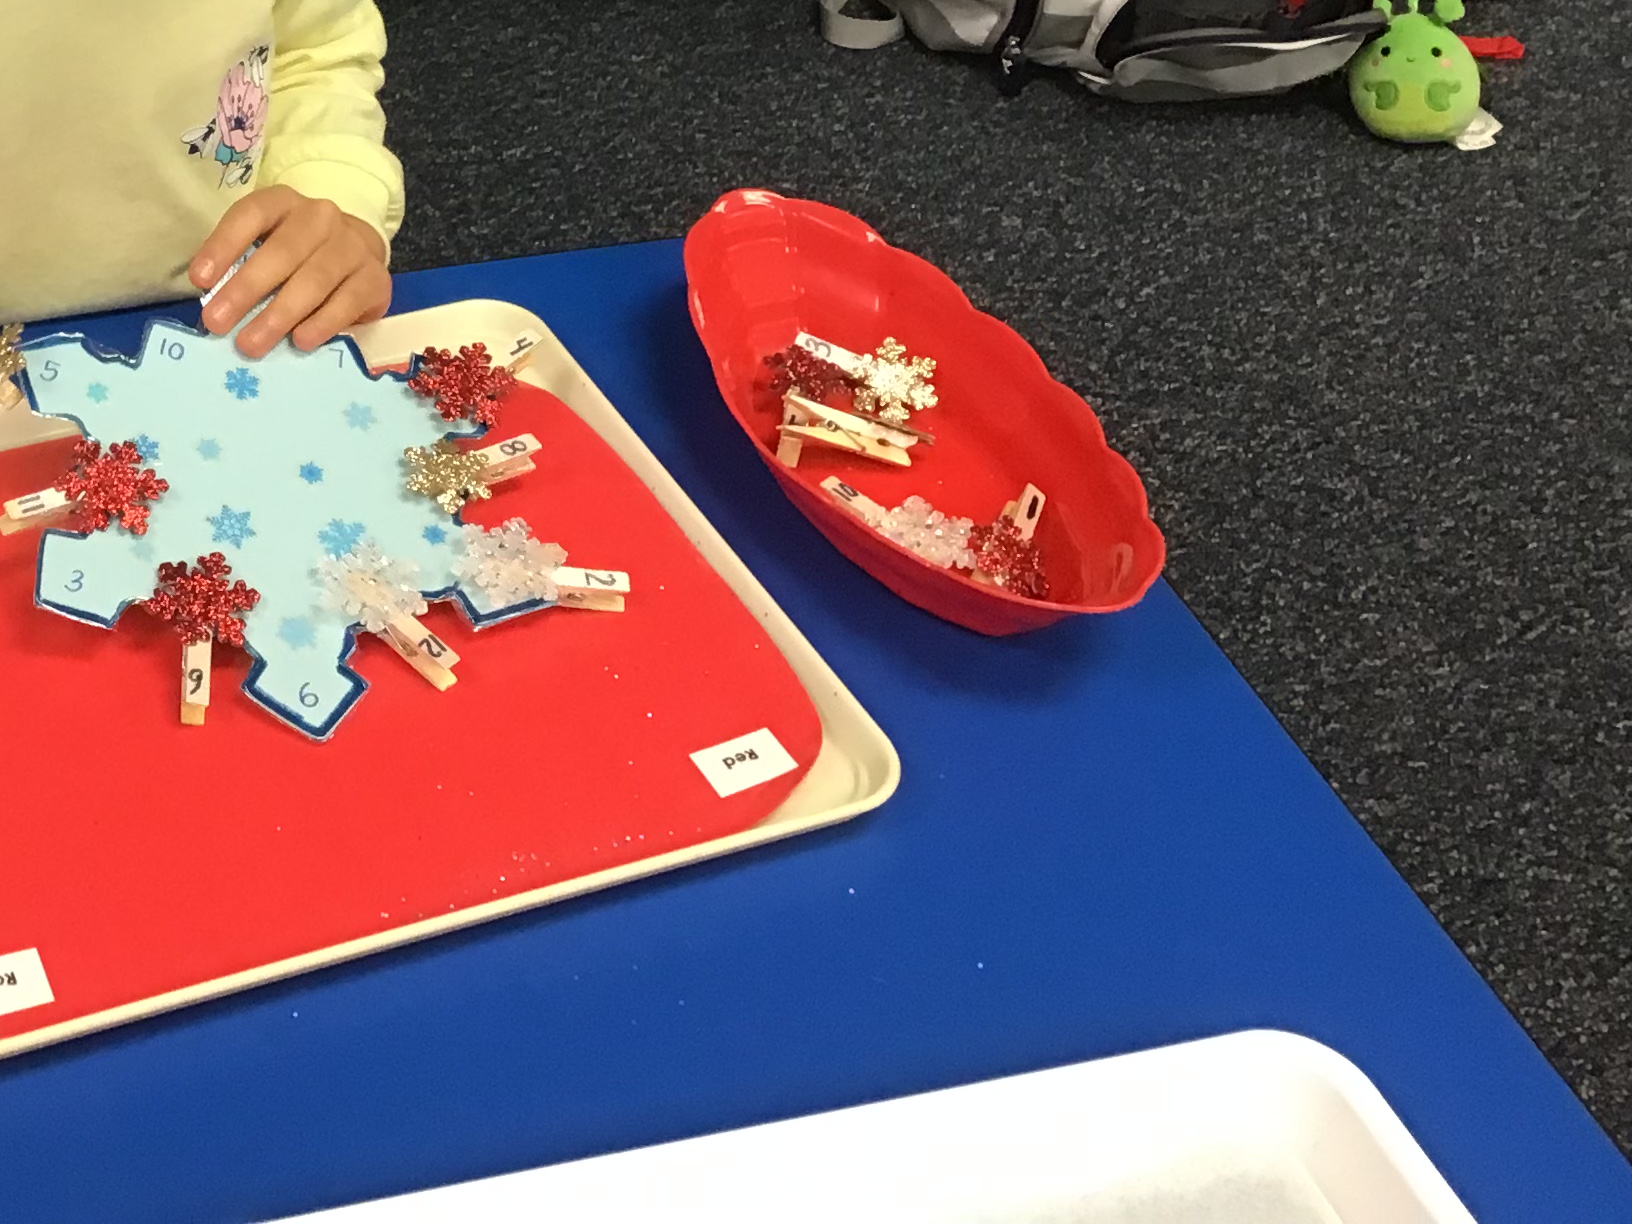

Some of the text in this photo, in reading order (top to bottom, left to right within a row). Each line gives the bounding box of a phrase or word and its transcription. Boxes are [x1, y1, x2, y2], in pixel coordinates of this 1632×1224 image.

[159, 337, 185, 361] 10
[328, 347, 344, 369] 7
[39, 359, 61, 382] 5
[499, 439, 528, 457] 8
[832, 482, 860, 503] 10
[17, 494, 45, 514] 11
[63, 569, 85, 593] 3
[584, 571, 618, 587] 2
[418, 633, 448, 658] 12
[298, 681, 320, 708] 6
[721, 748, 760, 770] Red
